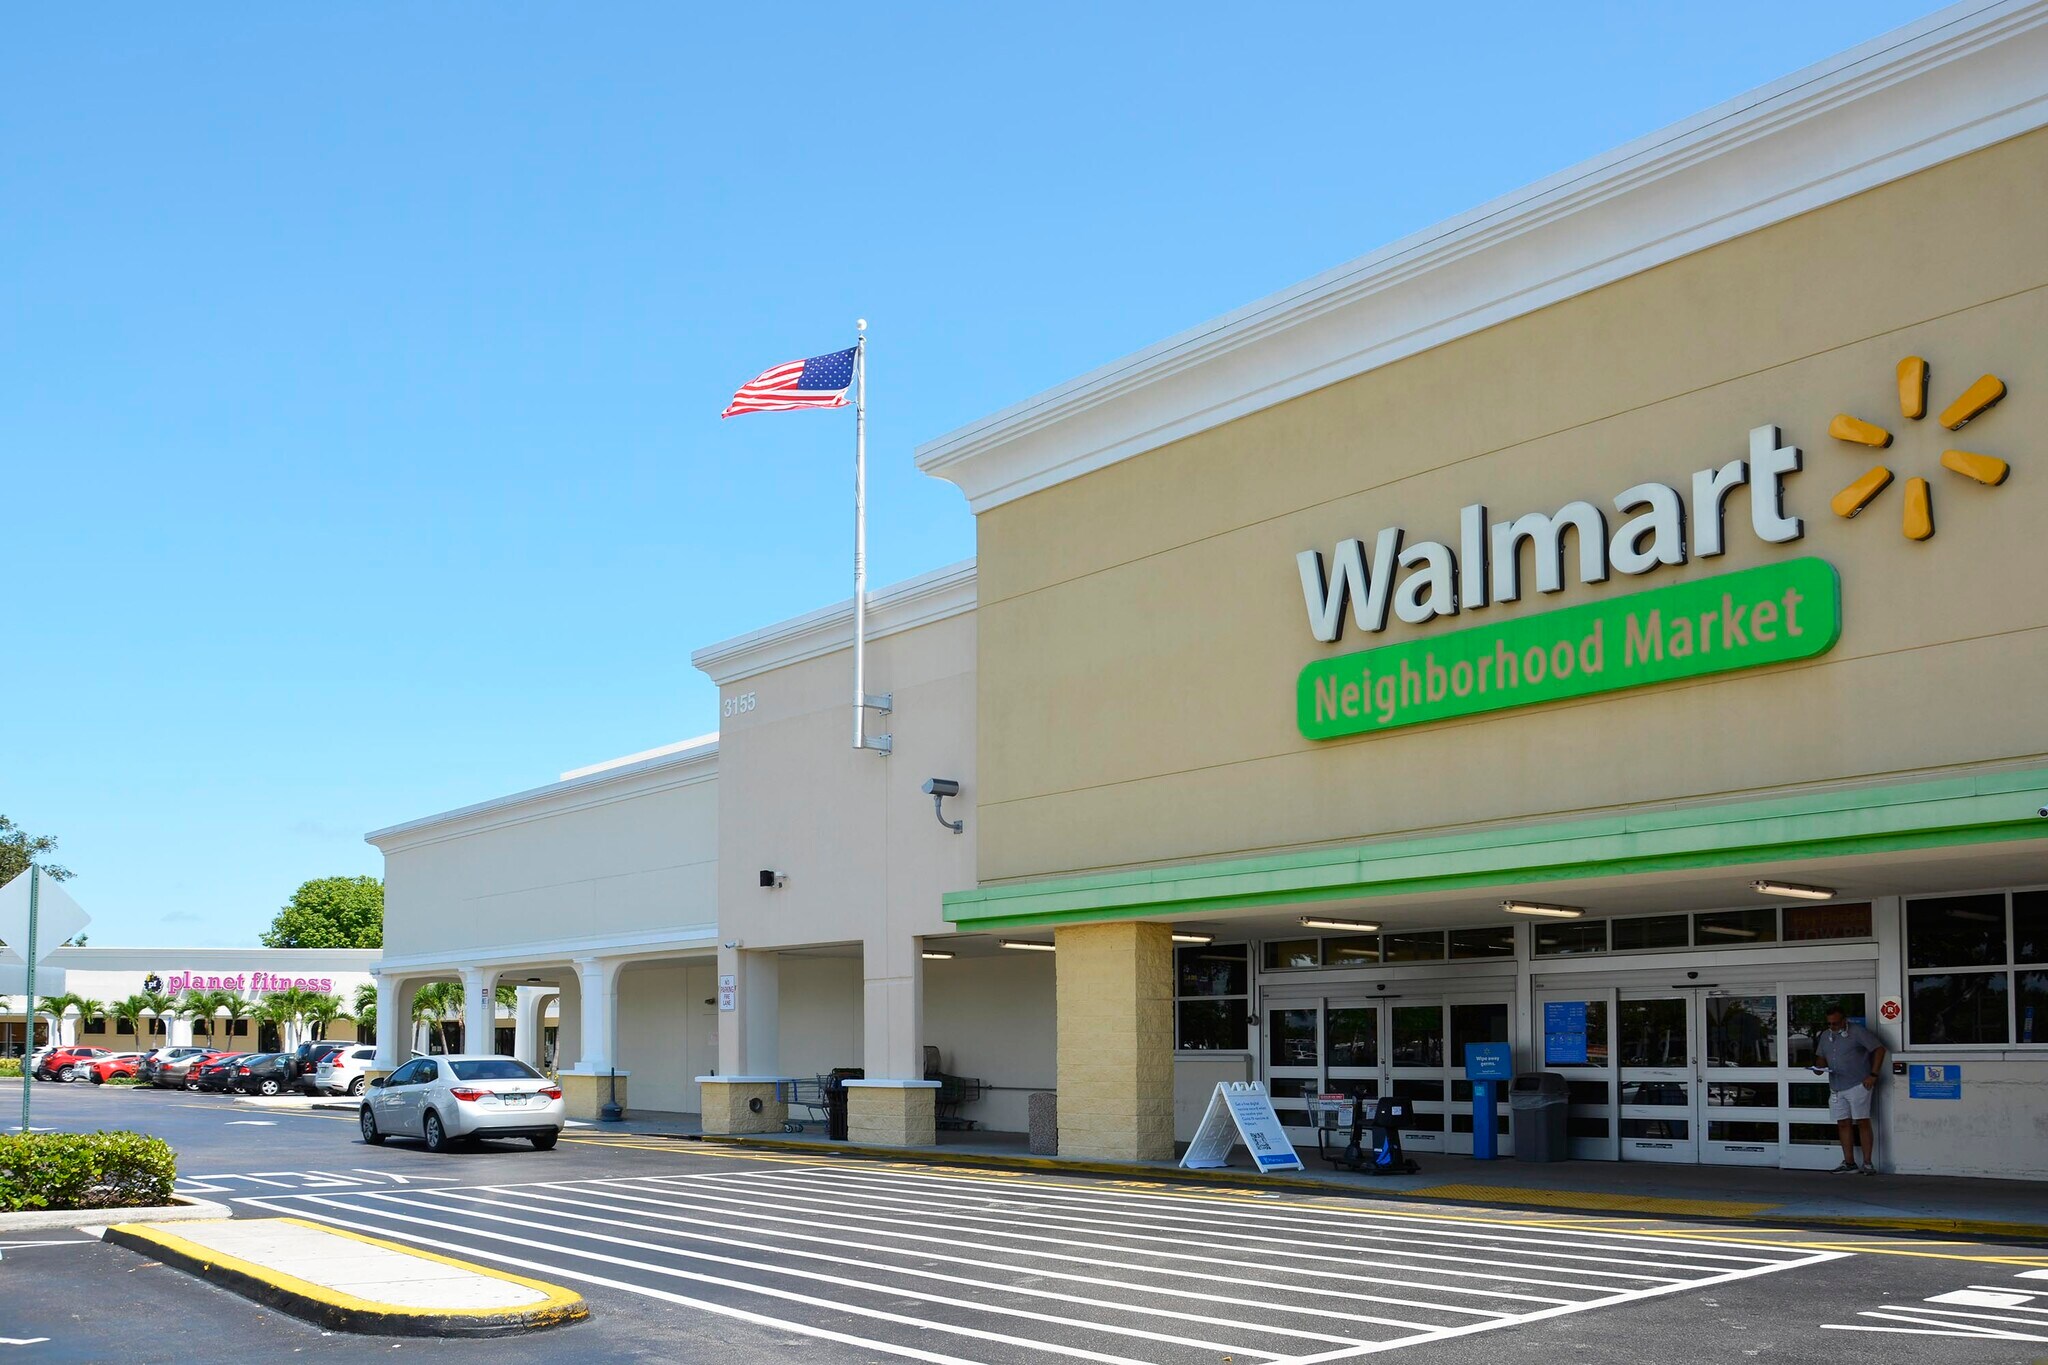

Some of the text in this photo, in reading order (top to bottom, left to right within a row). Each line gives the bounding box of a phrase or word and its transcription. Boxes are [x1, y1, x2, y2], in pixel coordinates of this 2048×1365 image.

[1296, 424, 1804, 643] Walmart
[1314, 587, 1804, 724] Neighborhood Market
[724, 691, 756, 717] 3155
[168, 971, 332, 994] planet fitness
